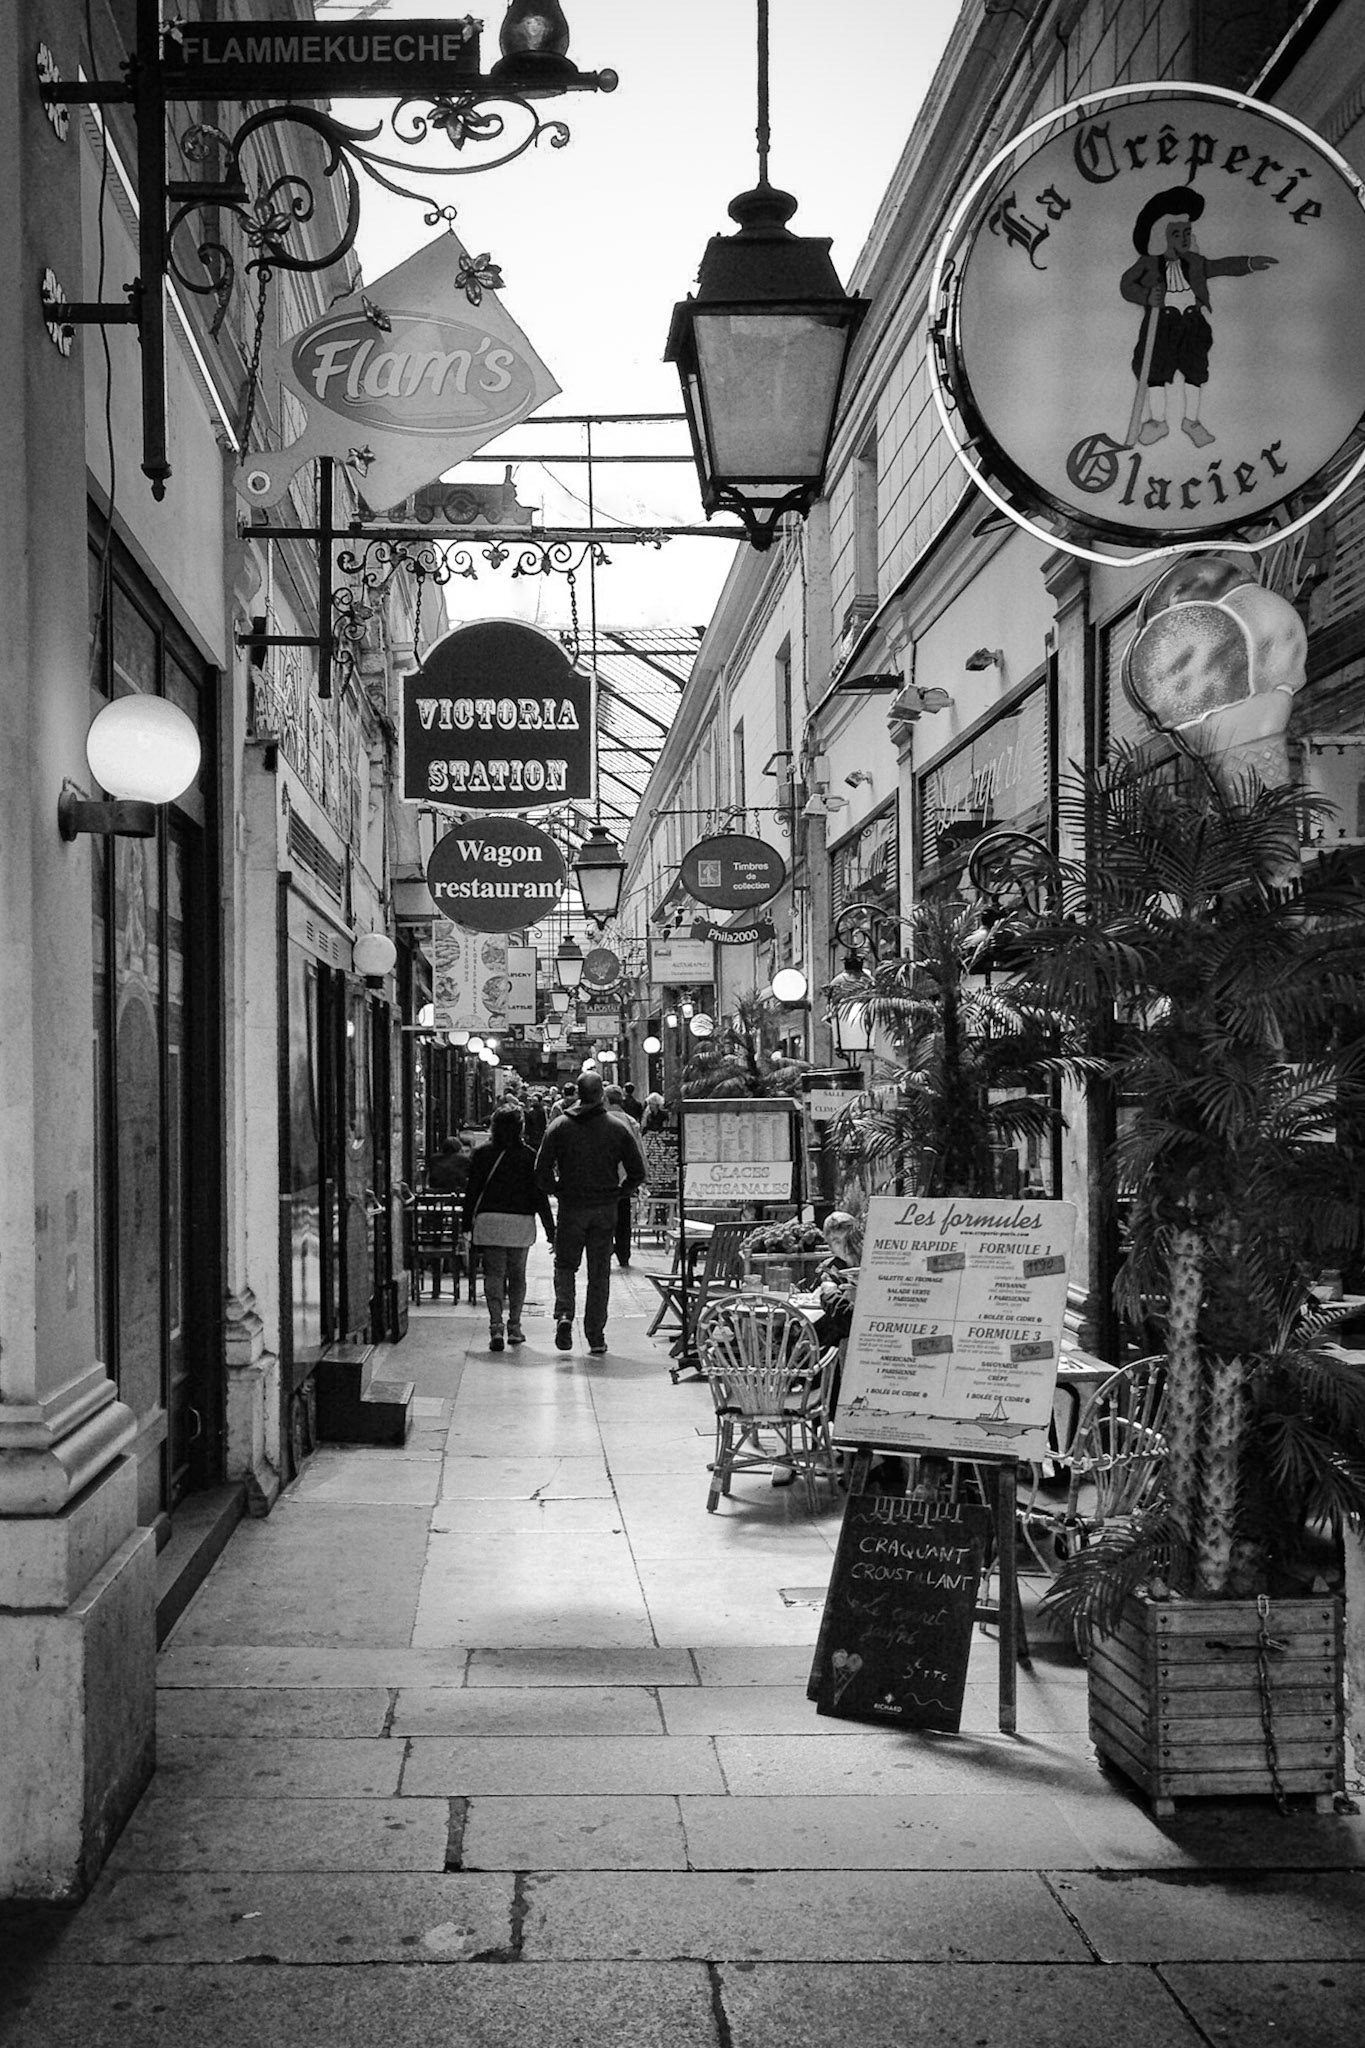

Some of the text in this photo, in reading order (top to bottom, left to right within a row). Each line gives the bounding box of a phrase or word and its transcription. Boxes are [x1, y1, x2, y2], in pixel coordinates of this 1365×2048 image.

[182, 35, 461, 63] FLAMMEKUECHE
[988, 120, 1323, 271] La Crêperie
[312, 336, 514, 399] Flam's
[1066, 432, 1288, 511] Glacier
[416, 698, 580, 730] VICTORIA
[428, 760, 568, 792] STATION
[456, 839, 543, 867] Wagon
[733, 861, 769, 871] Timbres
[434, 878, 564, 898] restaurant
[733, 882, 770, 890] collection
[708, 928, 759, 943] Phila2000
[894, 1203, 1042, 1236] Les formules
[873, 1239, 958, 1252] MENU RAPIDE
[979, 1242, 1051, 1255] FORMULE 1
[868, 1321, 938, 1335] FORMULE 2
[967, 1327, 1041, 1341] FORMULE 3
[1004, 1395, 1024, 1403] CIDRE
[859, 1536, 971, 1564] CRAQUANT
[873, 1703, 903, 1712] RICHARD
